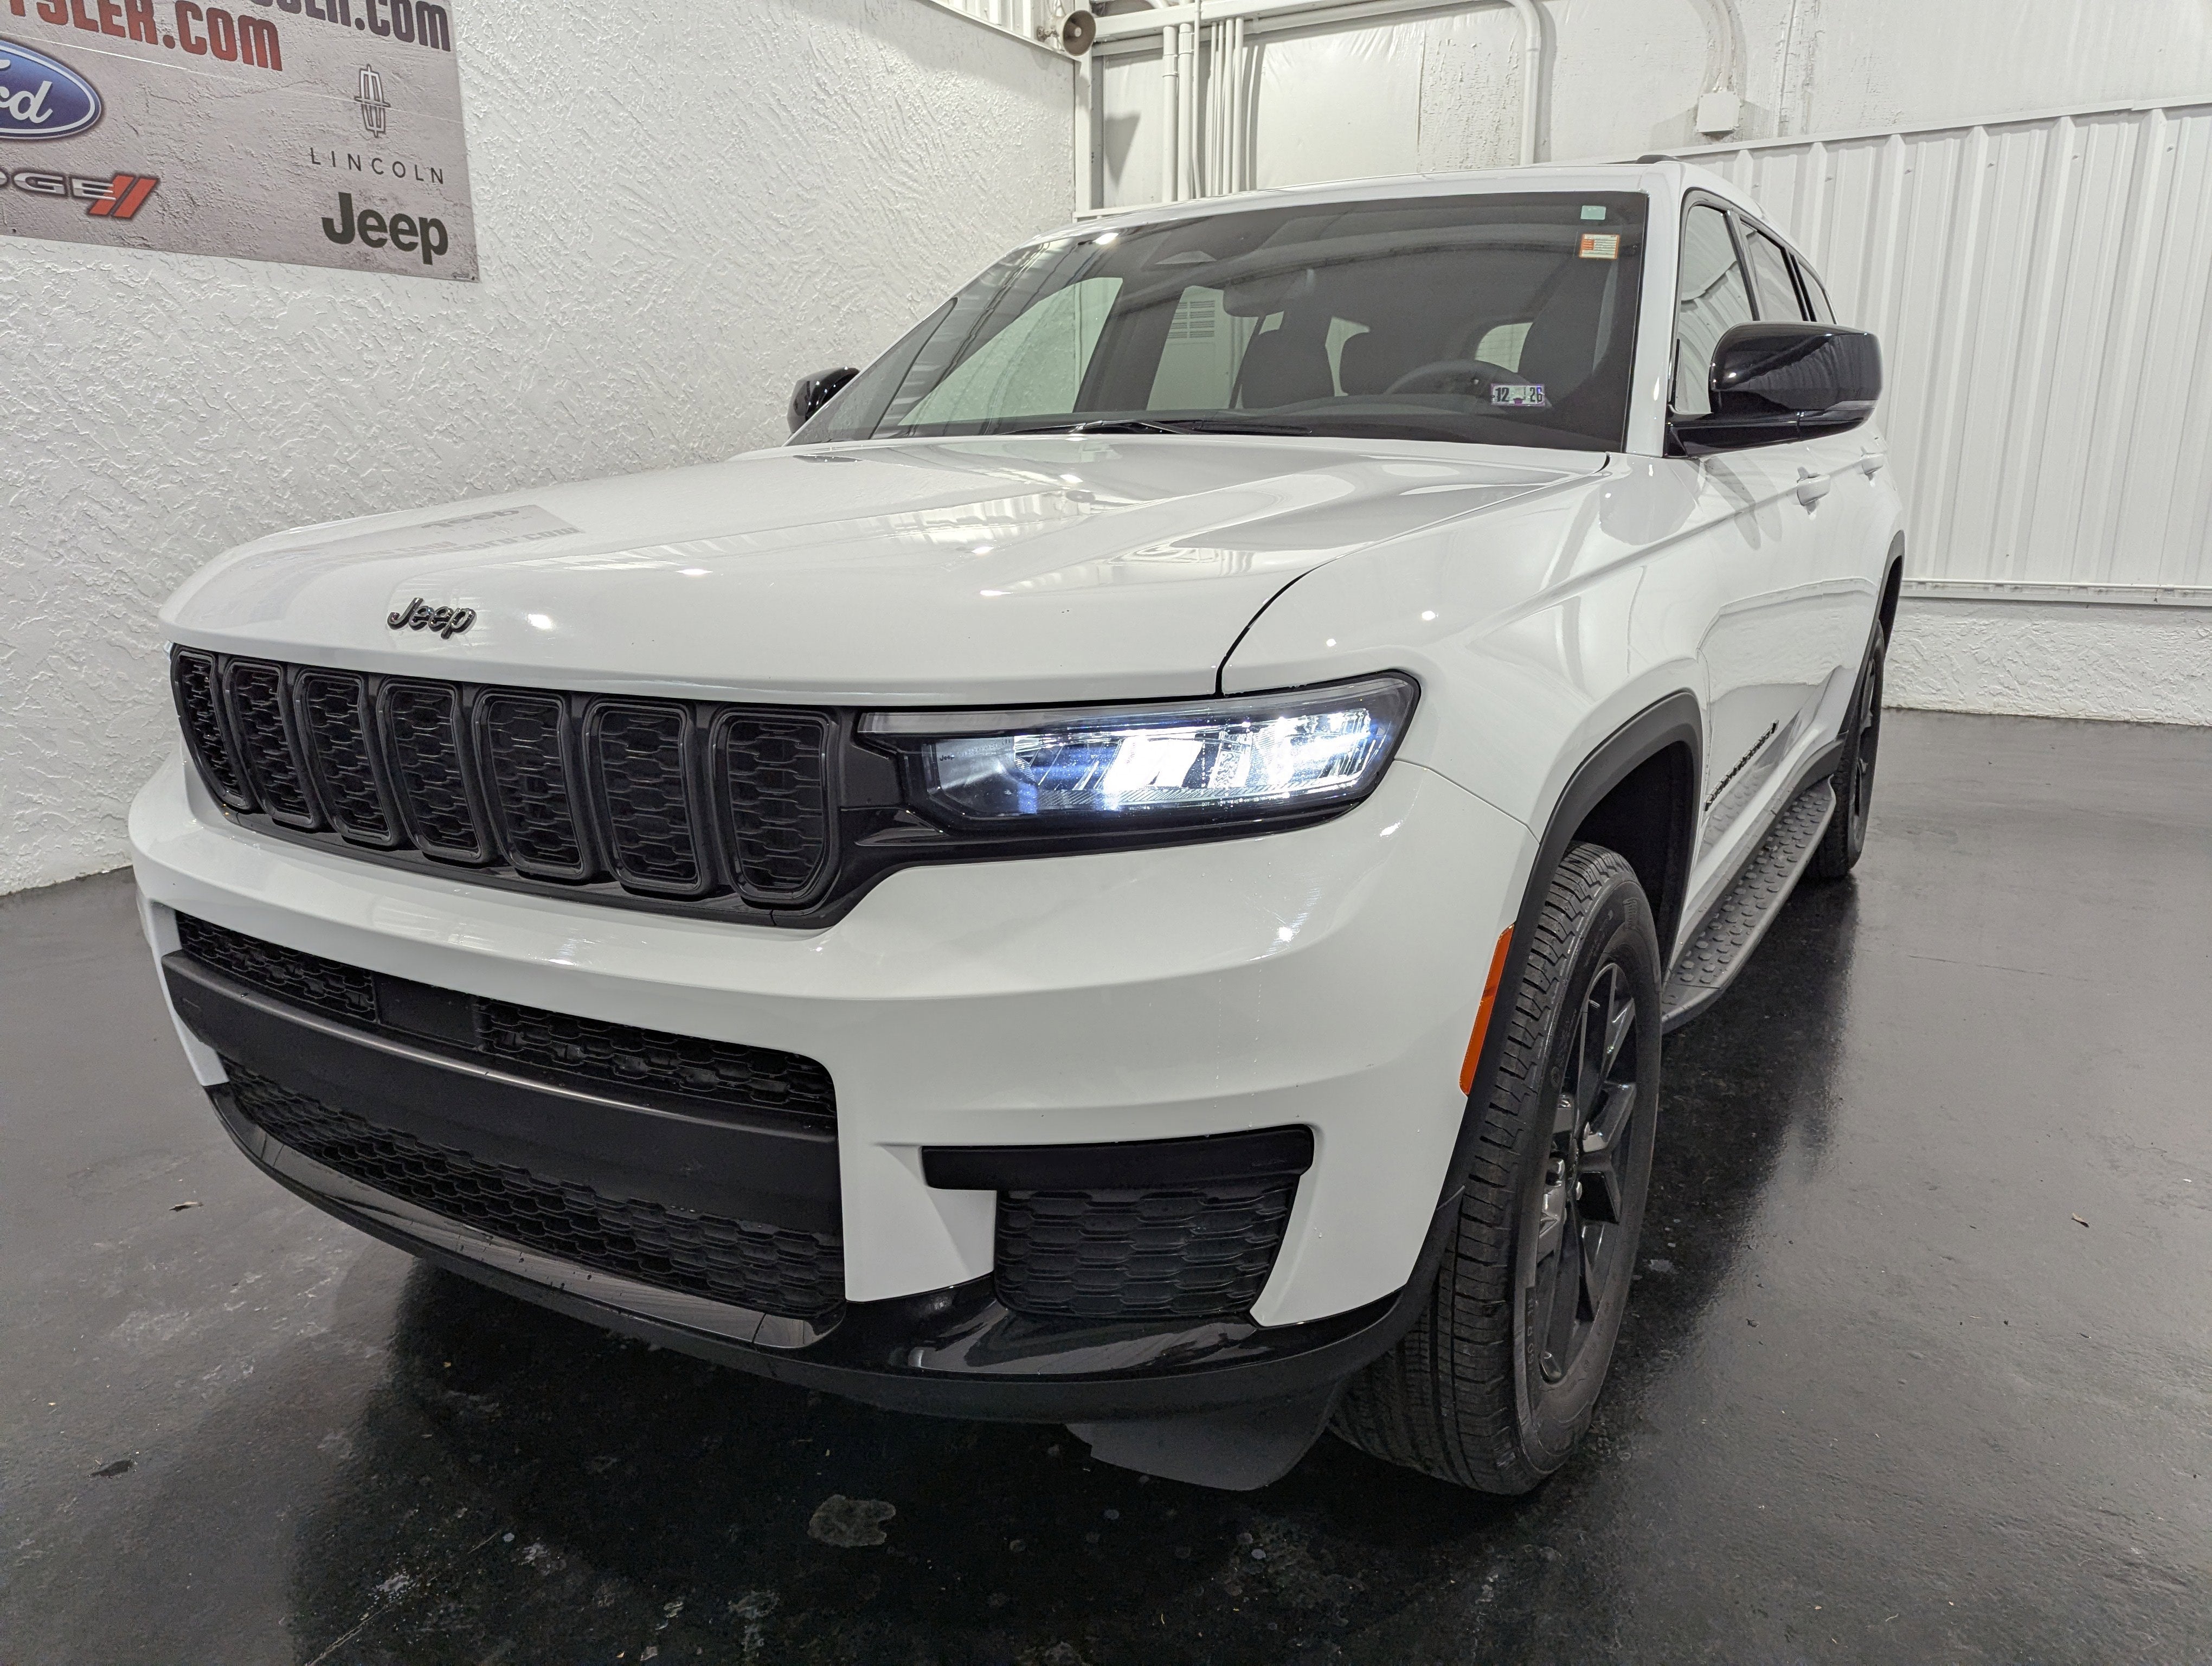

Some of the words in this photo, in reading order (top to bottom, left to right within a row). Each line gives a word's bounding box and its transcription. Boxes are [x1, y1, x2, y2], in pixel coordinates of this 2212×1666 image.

[310, 147, 443, 184] LINCOLN
[321, 191, 448, 265] Jeep
[1496, 387, 1509, 402] 12
[387, 597, 477, 640] Jeep
